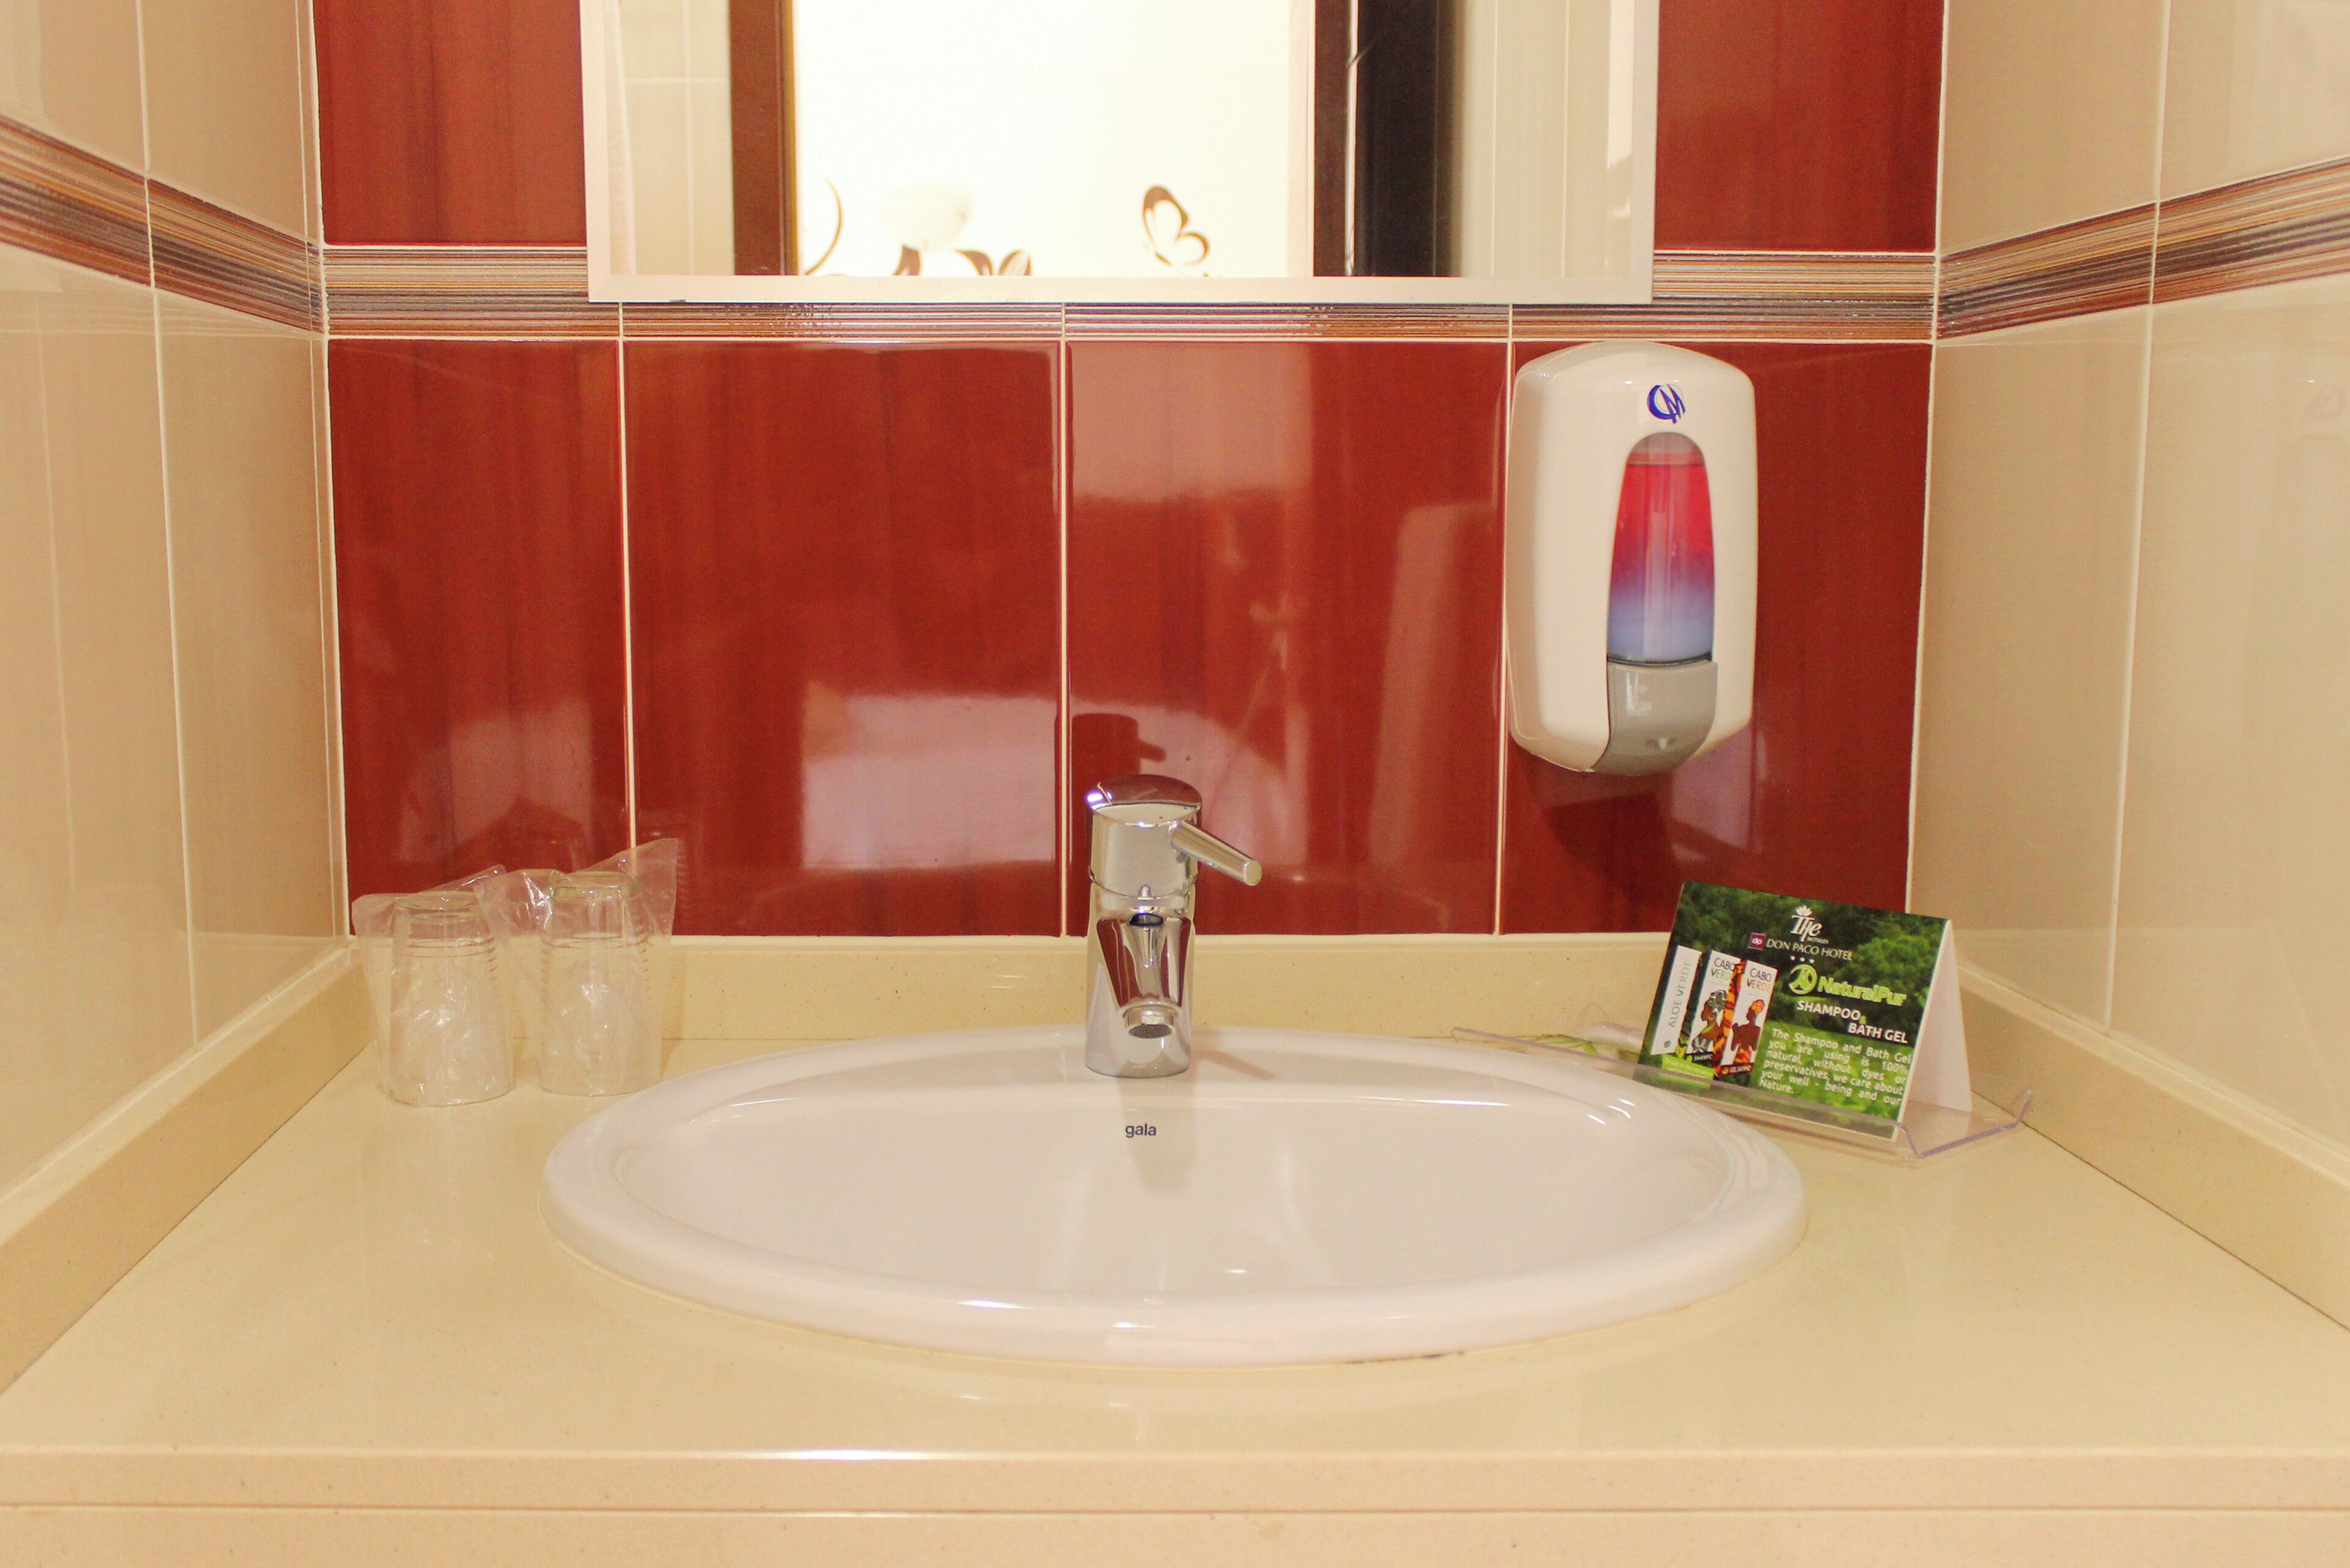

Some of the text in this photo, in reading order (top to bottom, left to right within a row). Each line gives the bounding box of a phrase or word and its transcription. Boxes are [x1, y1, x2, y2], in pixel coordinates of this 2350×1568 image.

[1767, 939, 1852, 961] DON PACO HOTEL
[1714, 957, 1734, 971] CABO
[1711, 968, 1732, 981] VERD
[1750, 968, 1772, 982] CABO
[1668, 962, 1692, 1028] ALOE VERDE
[1747, 978, 1772, 992] VERDE
[1818, 976, 1908, 1006] NaturalPur
[1797, 1000, 1861, 1020] SHAMPOO
[1848, 1023, 1908, 1043] BATH GEL
[1772, 1028, 1789, 1039] The
[1794, 1032, 1838, 1048] Shampoo
[1843, 1044, 1862, 1054] and
[1867, 1047, 1890, 1059] Bath
[1768, 1040, 1909, 1074] you are using is 100%
[1813, 1059, 1851, 1073] without
[1861, 1068, 1884, 1080] dyes
[1759, 1078, 1794, 1094] Nature.
[1761, 1070, 1784, 1081] your
[1789, 1075, 1810, 1086] well
[1826, 1078, 1852, 1097] being
[1859, 1091, 1878, 1101] and
[1884, 1096, 1902, 1105] our
[1833, 1074, 1848, 1083] we
[1851, 1078, 1871, 1089] care
[1874, 1082, 1904, 1095] about
[1125, 1123, 1156, 1138] gala
